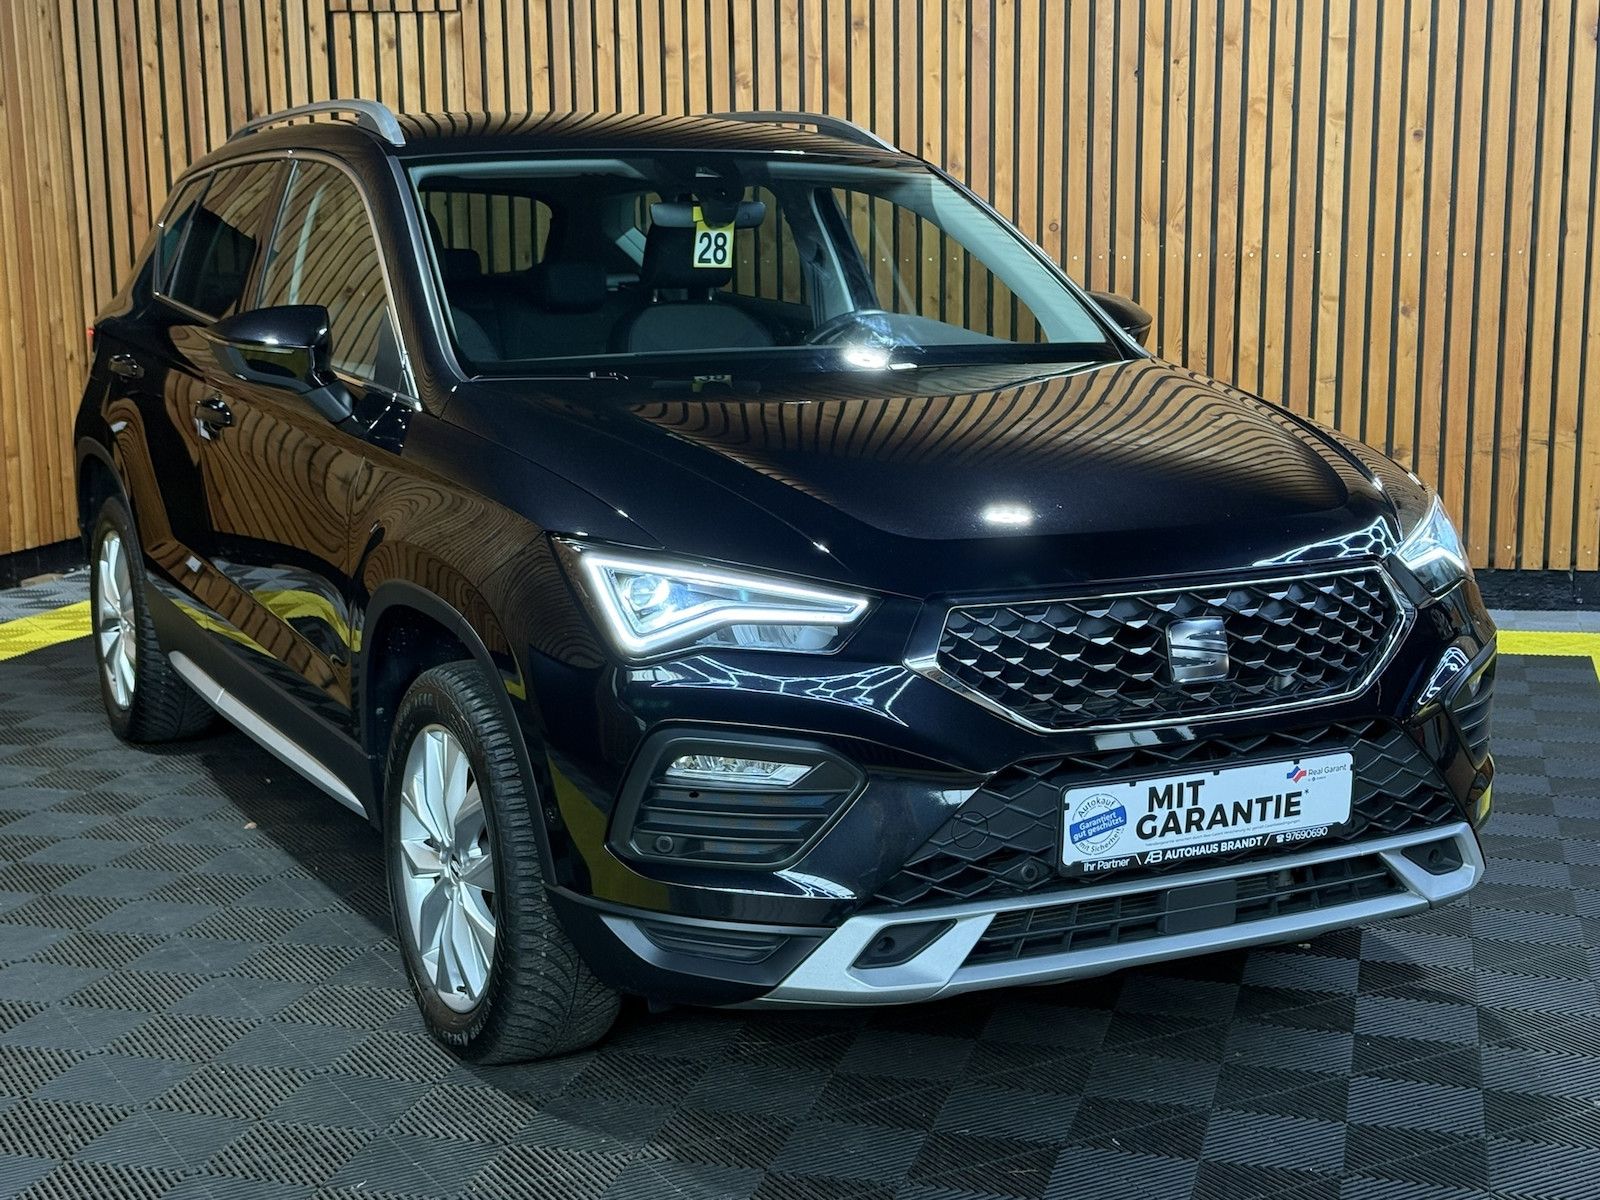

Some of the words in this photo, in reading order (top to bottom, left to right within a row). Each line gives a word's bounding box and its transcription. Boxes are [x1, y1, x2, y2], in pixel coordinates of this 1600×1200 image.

[698, 232, 727, 264] 28
[1308, 767, 1323, 776] Real
[1324, 764, 1347, 774] Garant
[1148, 780, 1205, 812] MIT
[1078, 797, 1116, 818] Autokauf
[1079, 812, 1117, 830] Garantiert
[1073, 831, 1087, 841] gut
[1165, 842, 1219, 861] AUTOHAUS
[1221, 835, 1263, 852] BRANDT
[1285, 827, 1328, 842] 97690690
[1079, 841, 1090, 851] mit
[1084, 858, 1096, 871] Ihr
[1097, 857, 1130, 871] Partner
